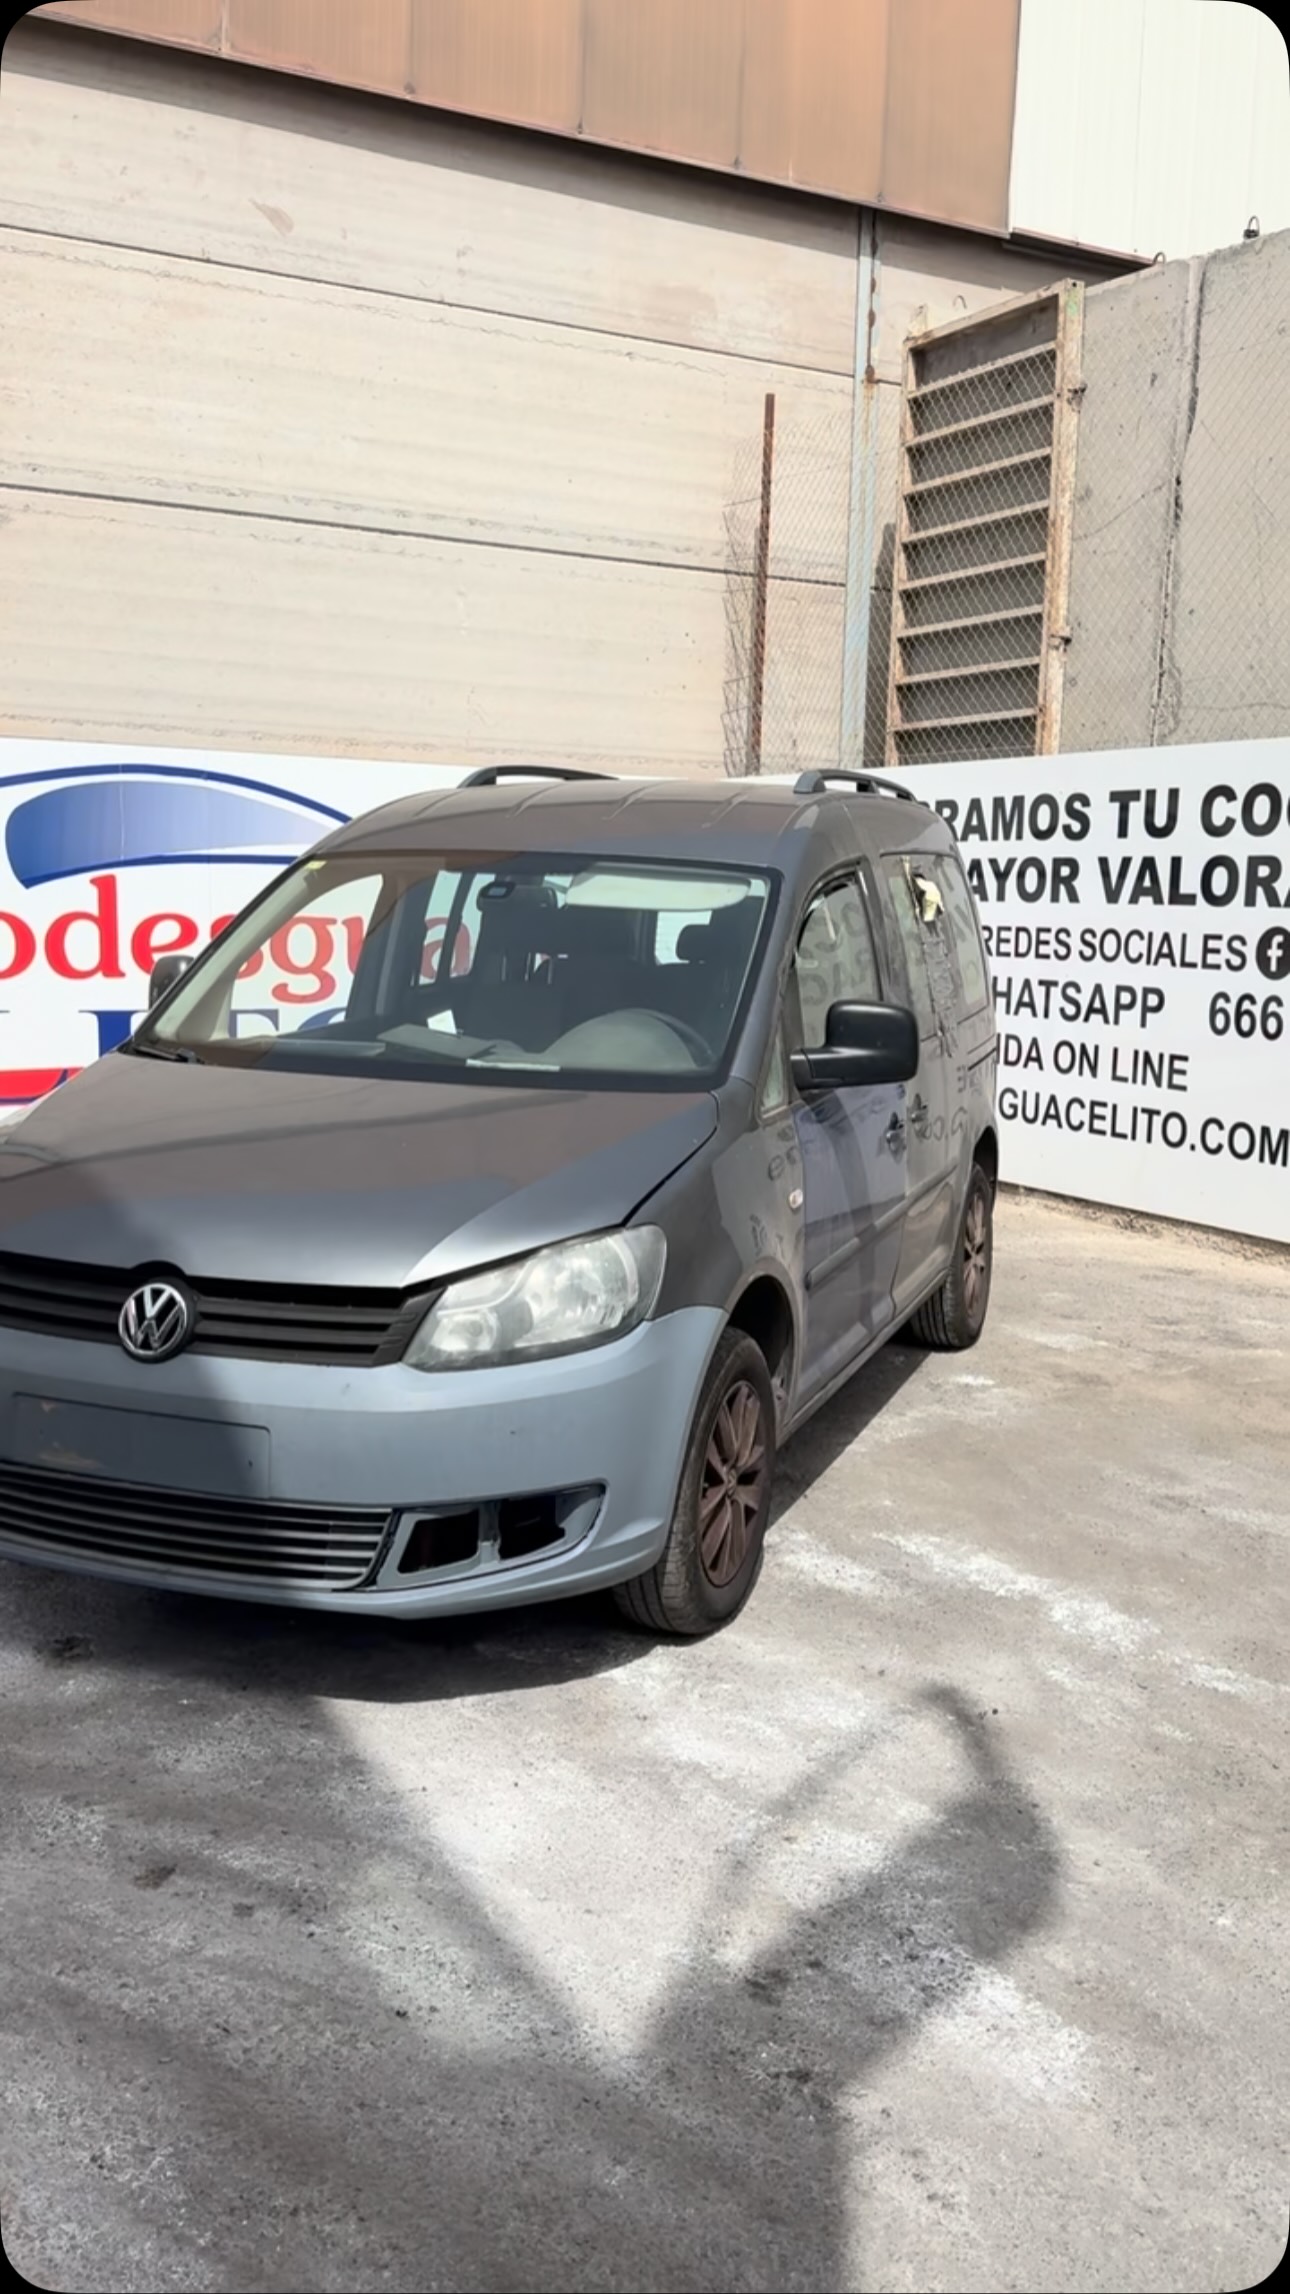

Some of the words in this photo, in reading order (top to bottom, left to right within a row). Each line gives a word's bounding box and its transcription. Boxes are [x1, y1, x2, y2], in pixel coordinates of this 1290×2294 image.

[918, 793, 1091, 842] RAMOS
[1109, 787, 1180, 839] TU
[1200, 782, 1290, 838] CO
[1098, 855, 1290, 908] VALOR
[1078, 927, 1248, 972] SOCIALES
[1209, 991, 1284, 1041] 666
[1053, 1040, 1099, 1079] ON
[1111, 1047, 1189, 1092] LINE
